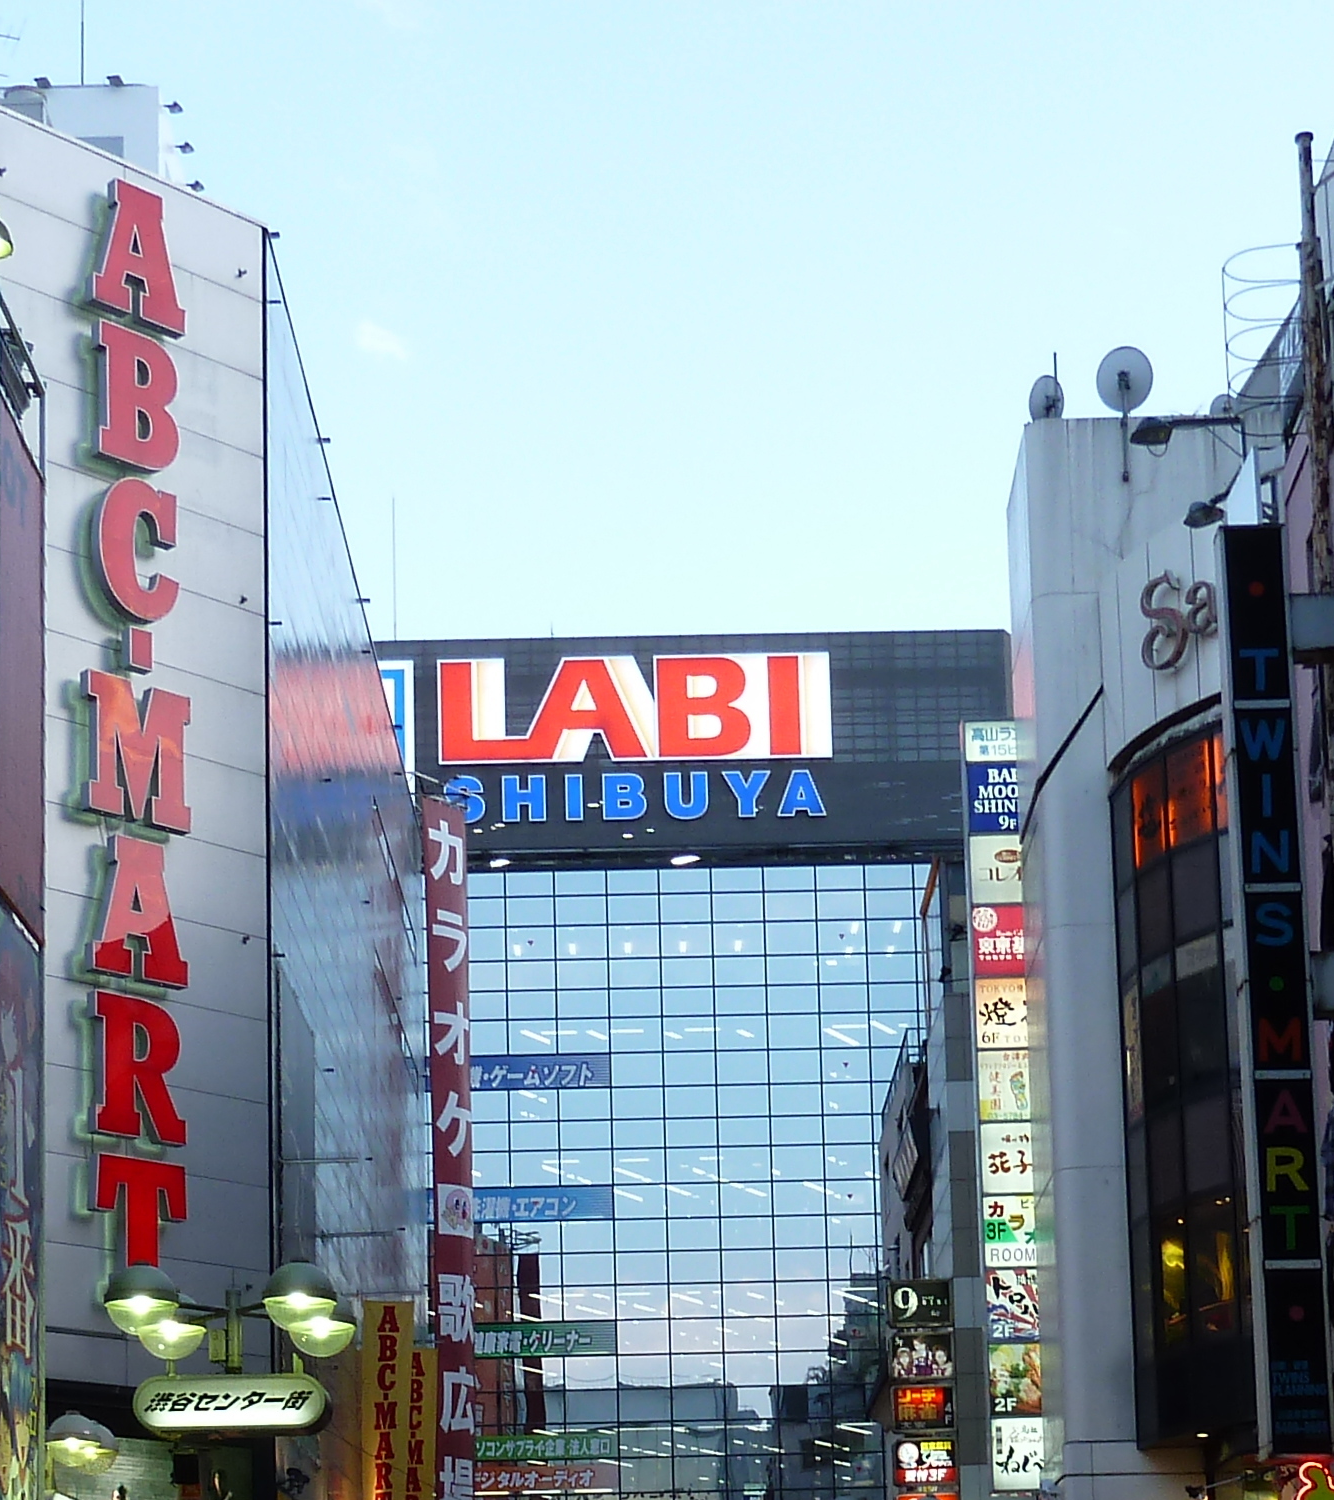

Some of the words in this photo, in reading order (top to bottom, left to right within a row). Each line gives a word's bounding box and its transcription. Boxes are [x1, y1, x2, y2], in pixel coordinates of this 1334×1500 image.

[437, 653, 833, 765] LABI
[444, 768, 827, 824] SHIBUYA
[1239, 648, 1295, 947] TWINS
[429, 818, 472, 1158] カラオケ
[982, 1031, 999, 1044] 6F
[1258, 1017, 1312, 1252] MART
[986, 1222, 1006, 1241] 3F
[990, 1248, 1035, 1263] ROOM
[993, 1324, 1014, 1338] 2F
[144, 1390, 312, 1412] 渋谷センター街
[994, 1397, 1017, 1412] 2F
